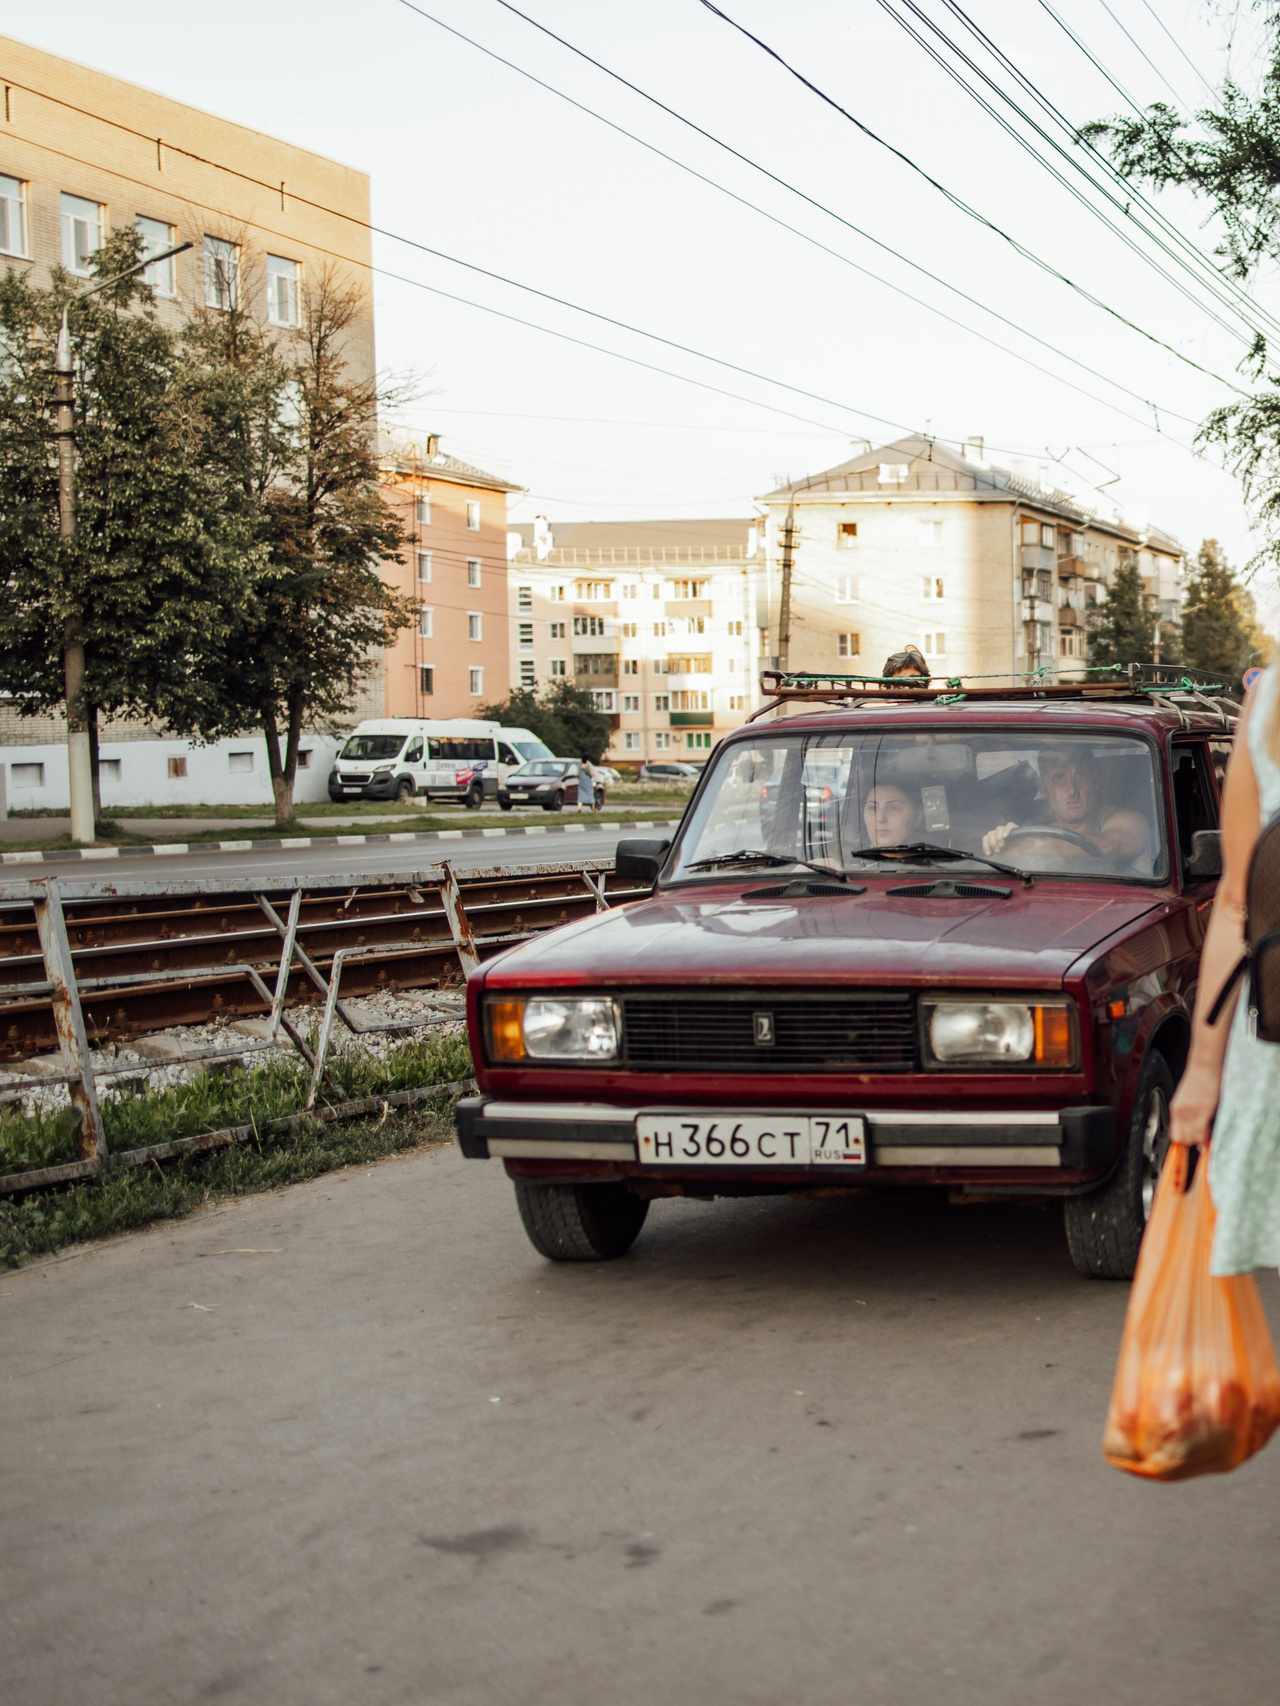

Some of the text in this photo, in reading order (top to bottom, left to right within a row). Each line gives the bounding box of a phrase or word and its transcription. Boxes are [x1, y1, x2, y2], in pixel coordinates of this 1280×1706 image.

[653, 1121, 851, 1158] Н366СТ 71
[814, 1149, 841, 1160] RUS
